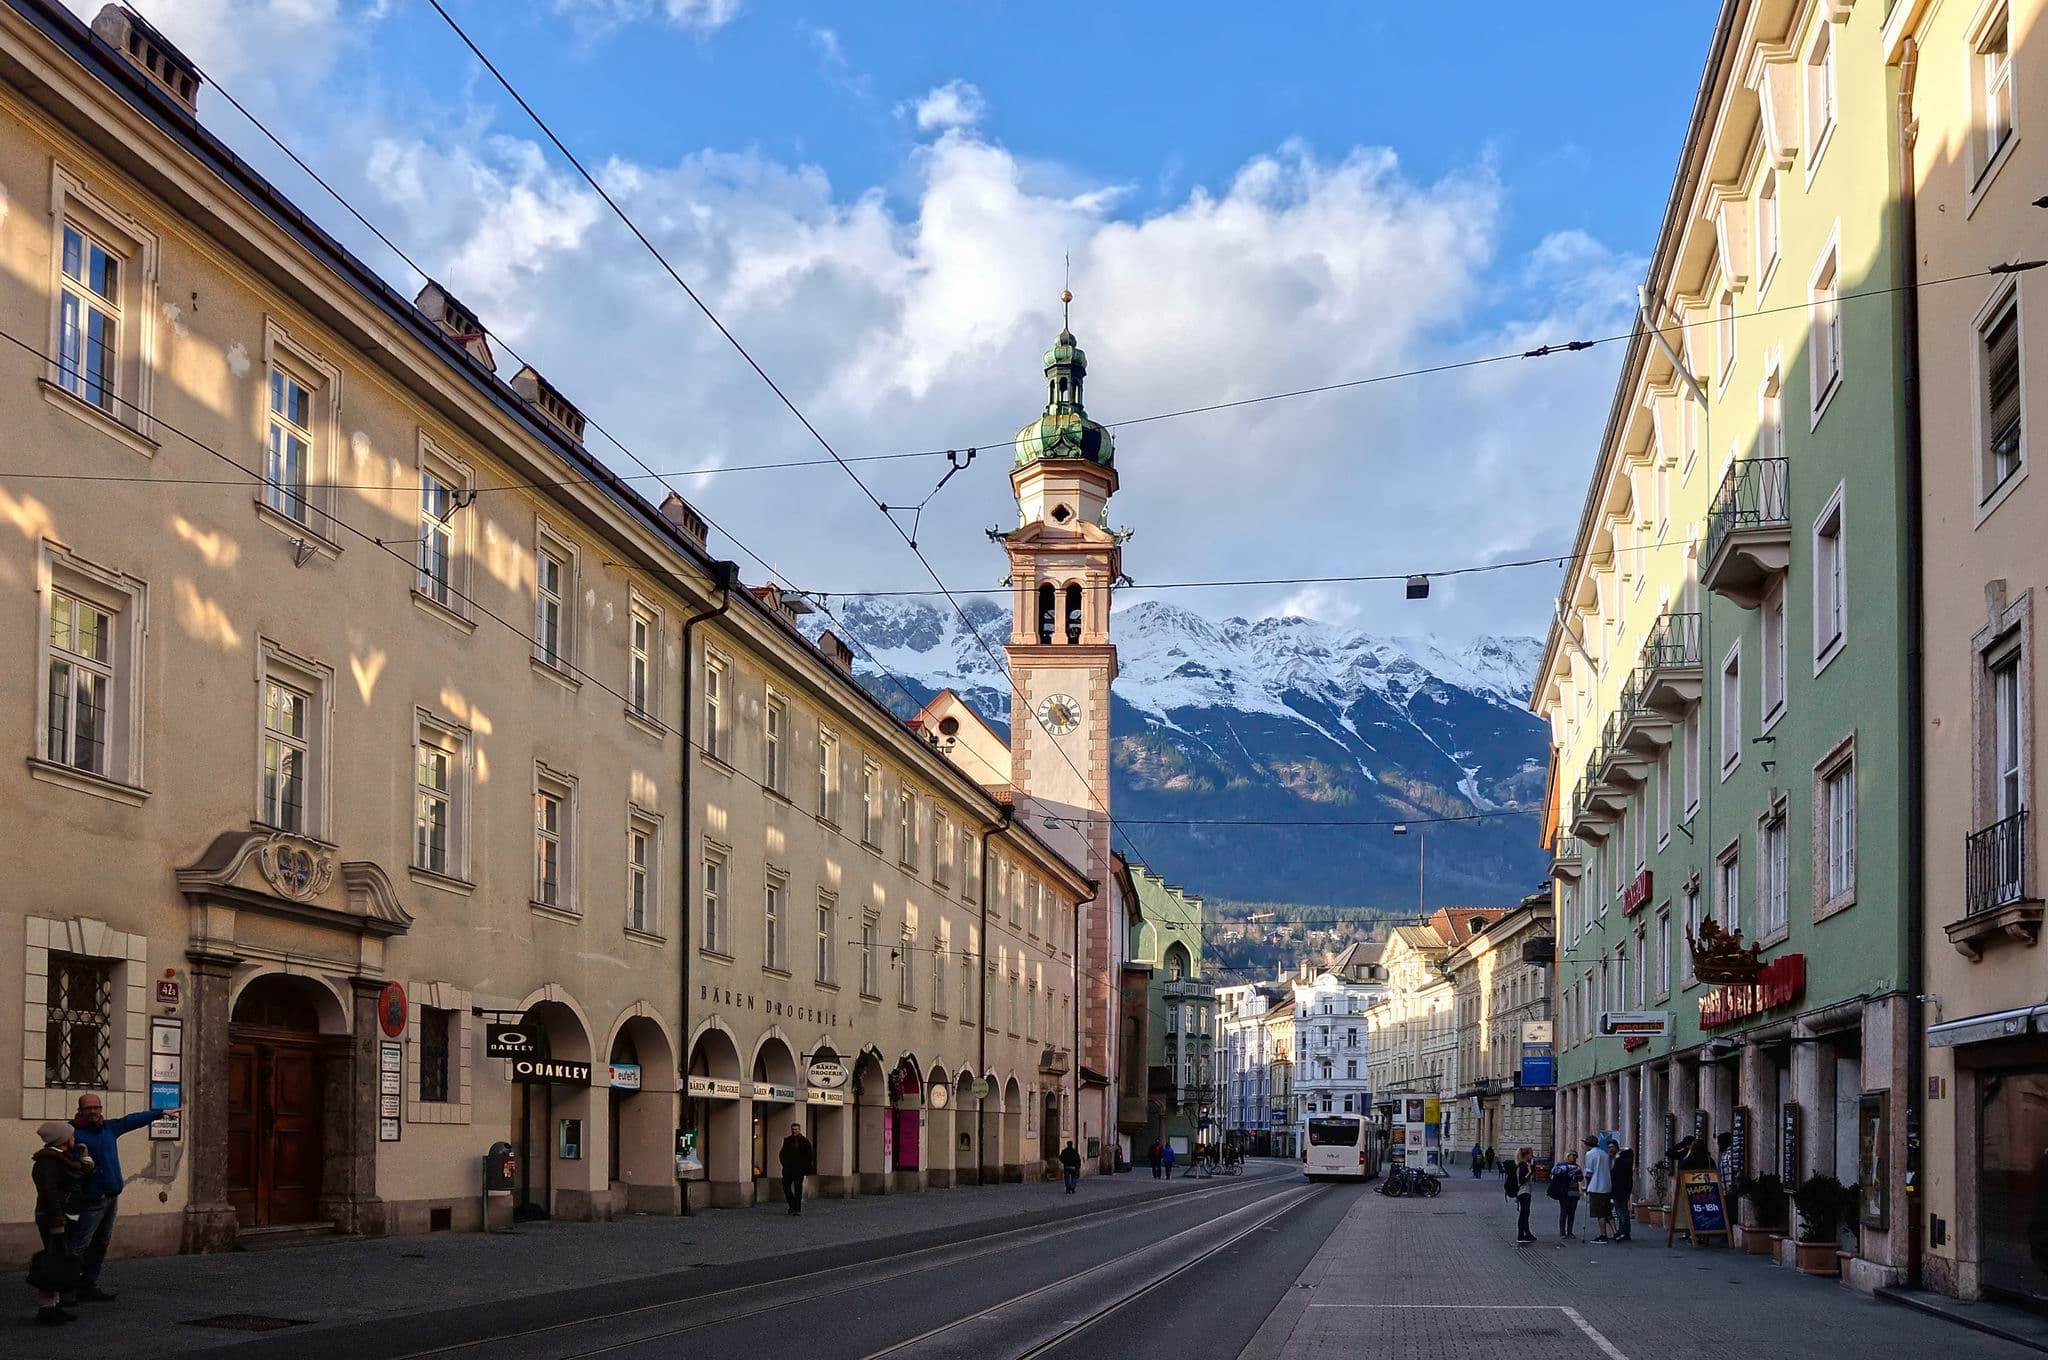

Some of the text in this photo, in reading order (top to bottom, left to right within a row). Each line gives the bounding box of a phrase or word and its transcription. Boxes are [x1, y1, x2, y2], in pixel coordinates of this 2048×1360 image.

[701, 985, 837, 1027] BÄREN DROGERIE
[490, 1044, 534, 1052] OAKLEY
[535, 1062, 588, 1080] OAKLEY
[816, 1063, 838, 1071] BÄREN
[1686, 1185, 1714, 1196] HAPPY
